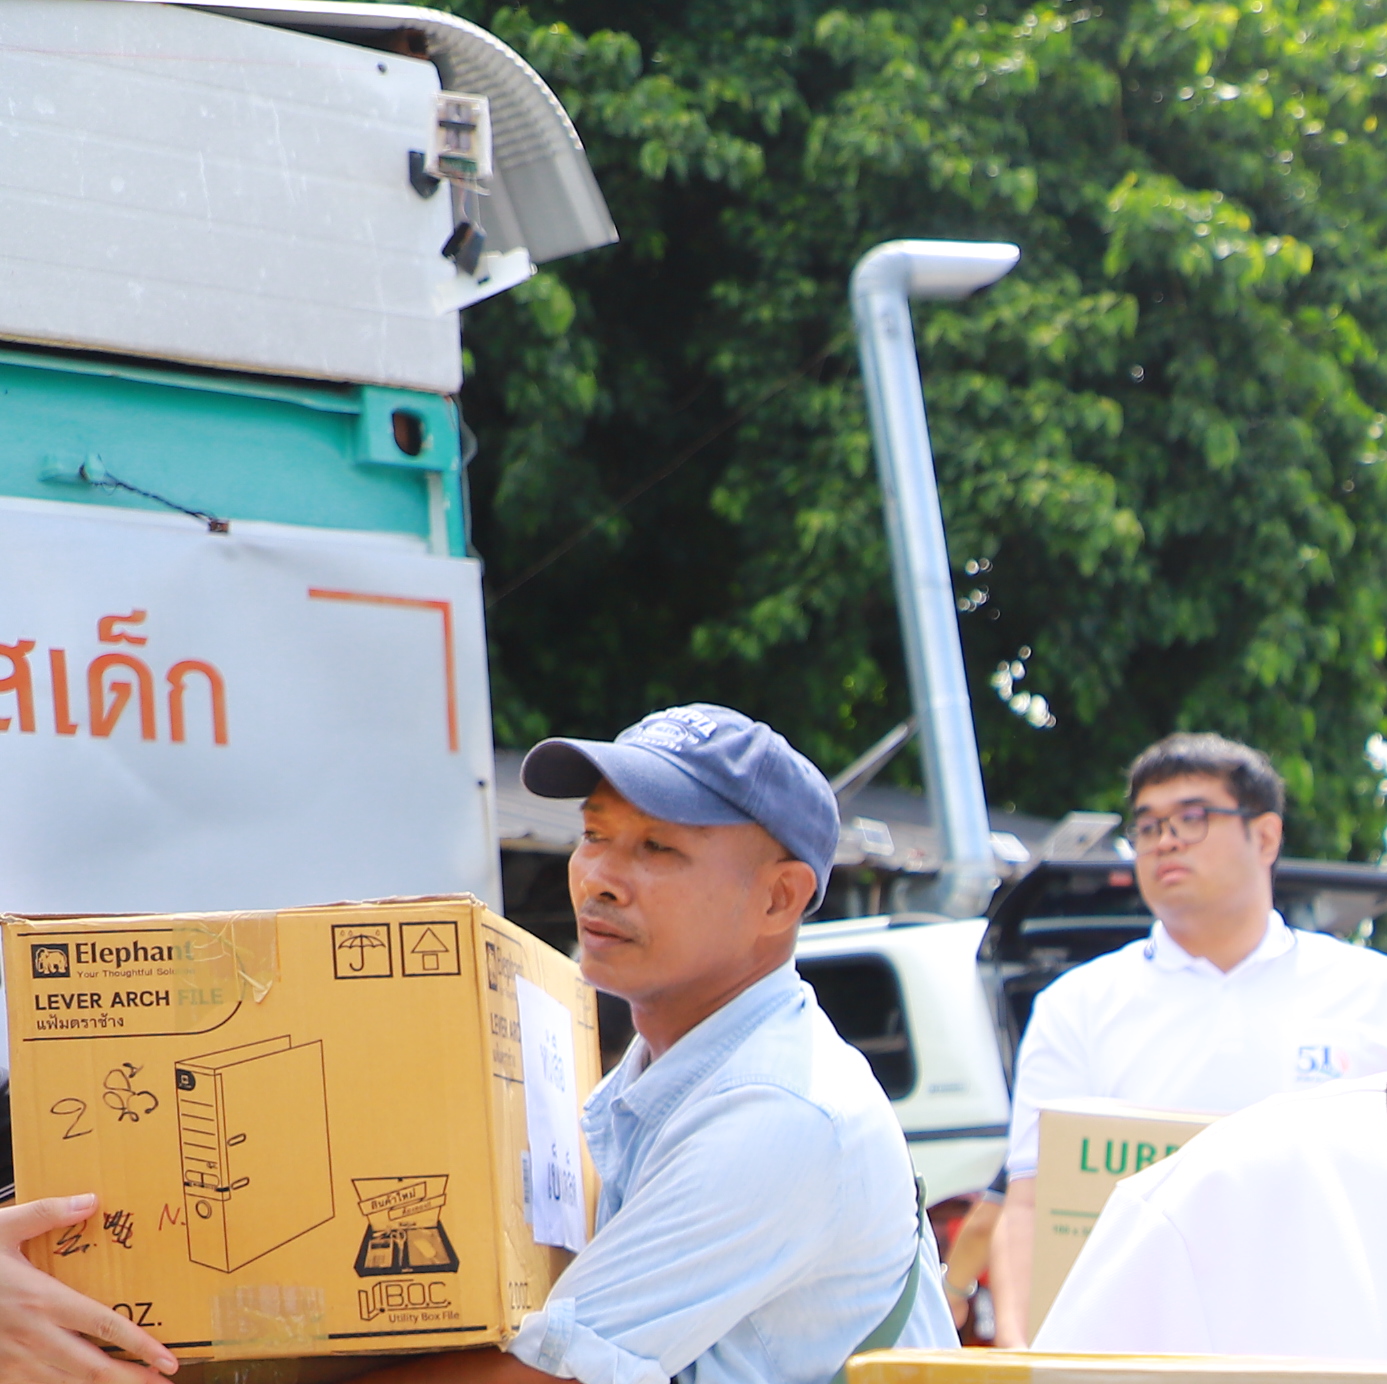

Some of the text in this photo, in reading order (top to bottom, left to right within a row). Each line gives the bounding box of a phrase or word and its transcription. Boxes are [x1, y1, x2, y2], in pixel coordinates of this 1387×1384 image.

[75, 940, 195, 968] Elephant
[77, 970, 99, 978] Your
[103, 968, 153, 978] Thoughtful
[34, 987, 224, 1011] LEVER ARCH FILE
[36, 1012, 124, 1031] แฟ้มตราช้าง
[388, 1310, 460, 1325] Utility Box File
